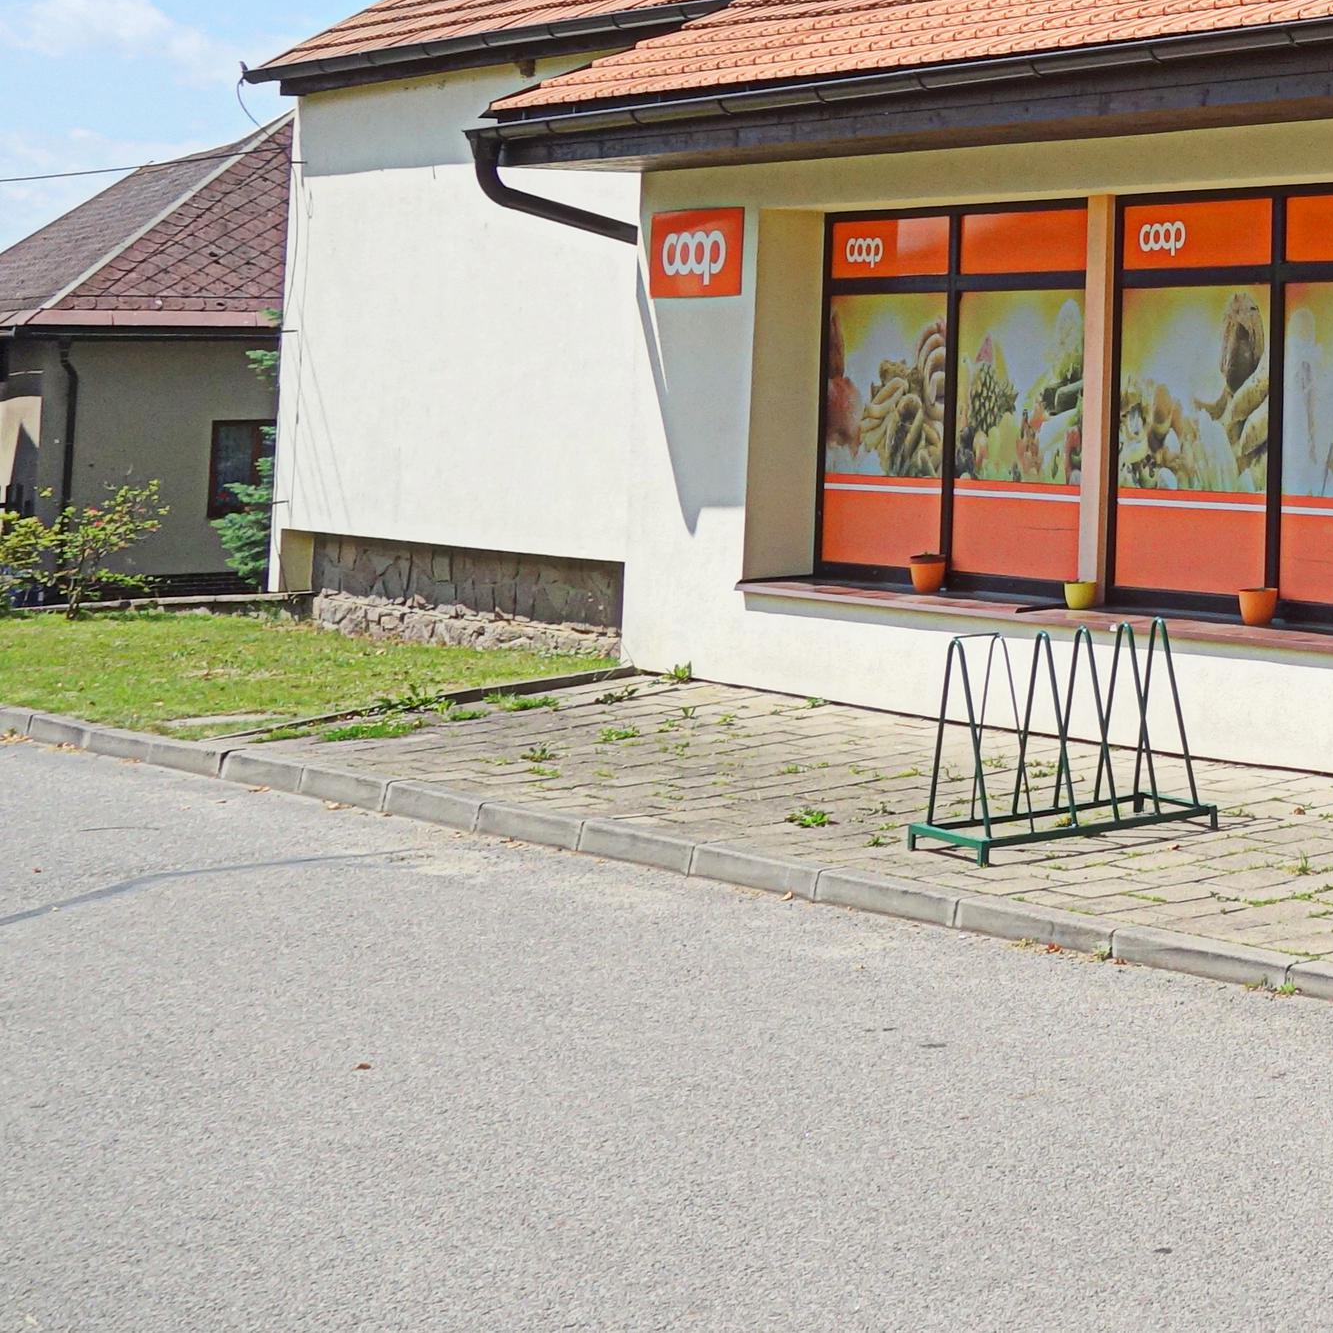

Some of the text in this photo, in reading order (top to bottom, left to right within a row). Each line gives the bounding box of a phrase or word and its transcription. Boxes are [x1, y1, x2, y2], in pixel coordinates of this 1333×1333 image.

[846, 237, 884, 268] coop
[1139, 220, 1186, 256] coop
[662, 230, 727, 286] coop
